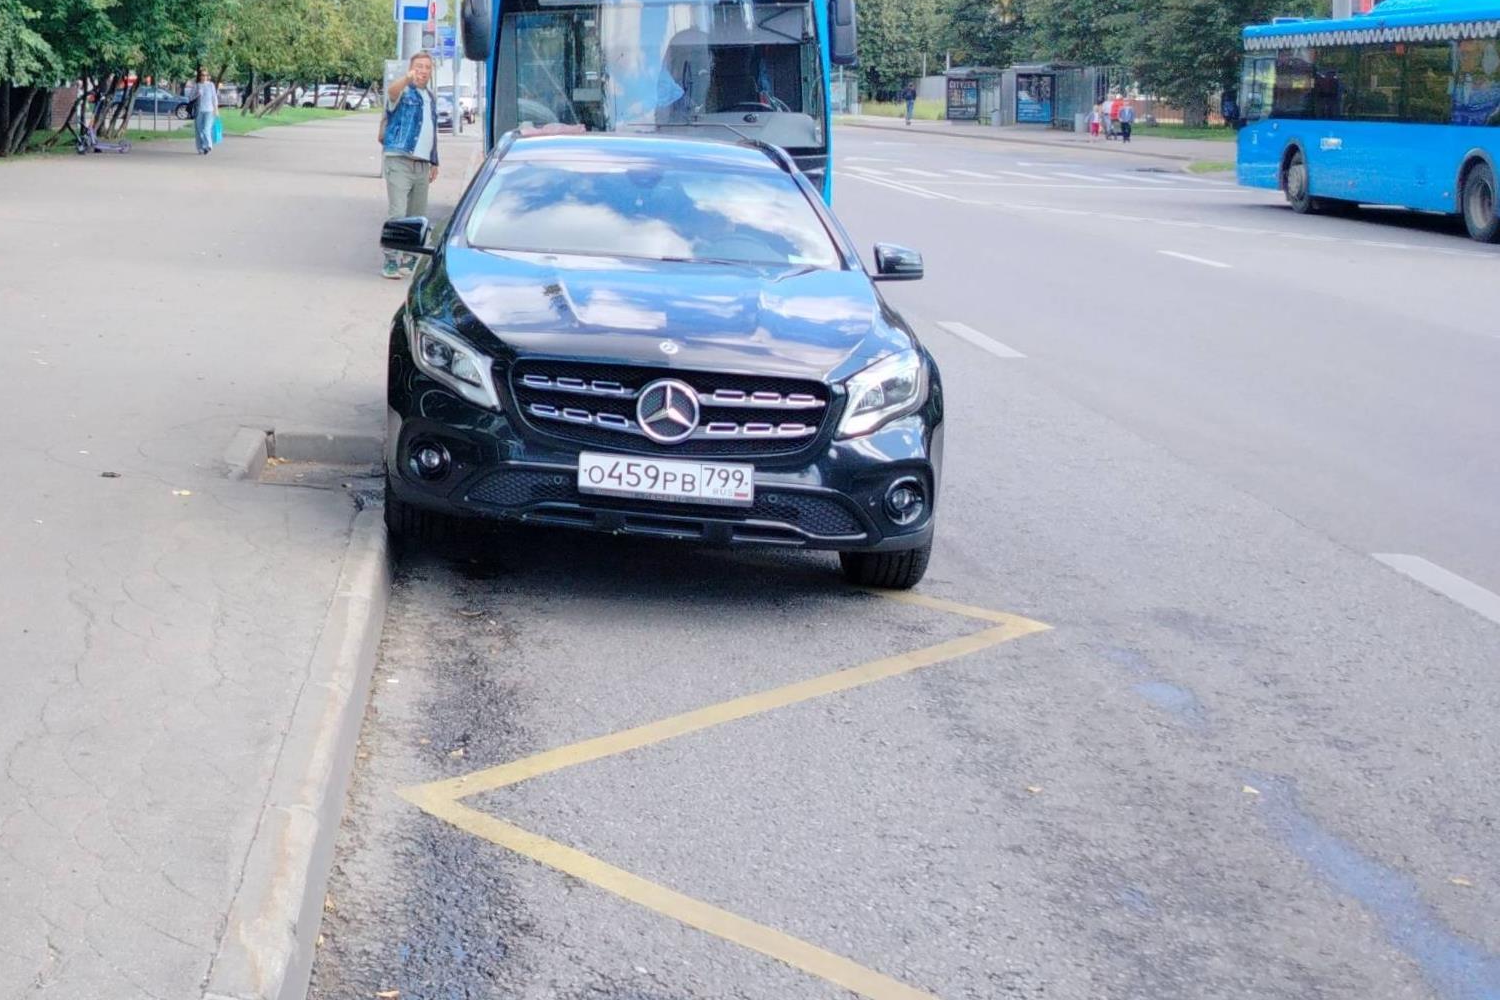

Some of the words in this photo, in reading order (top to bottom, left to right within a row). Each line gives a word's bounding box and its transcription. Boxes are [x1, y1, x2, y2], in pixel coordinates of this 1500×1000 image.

[588, 461, 696, 493] О459РВ
[704, 467, 745, 489] 799
[712, 487, 733, 496] RUS
